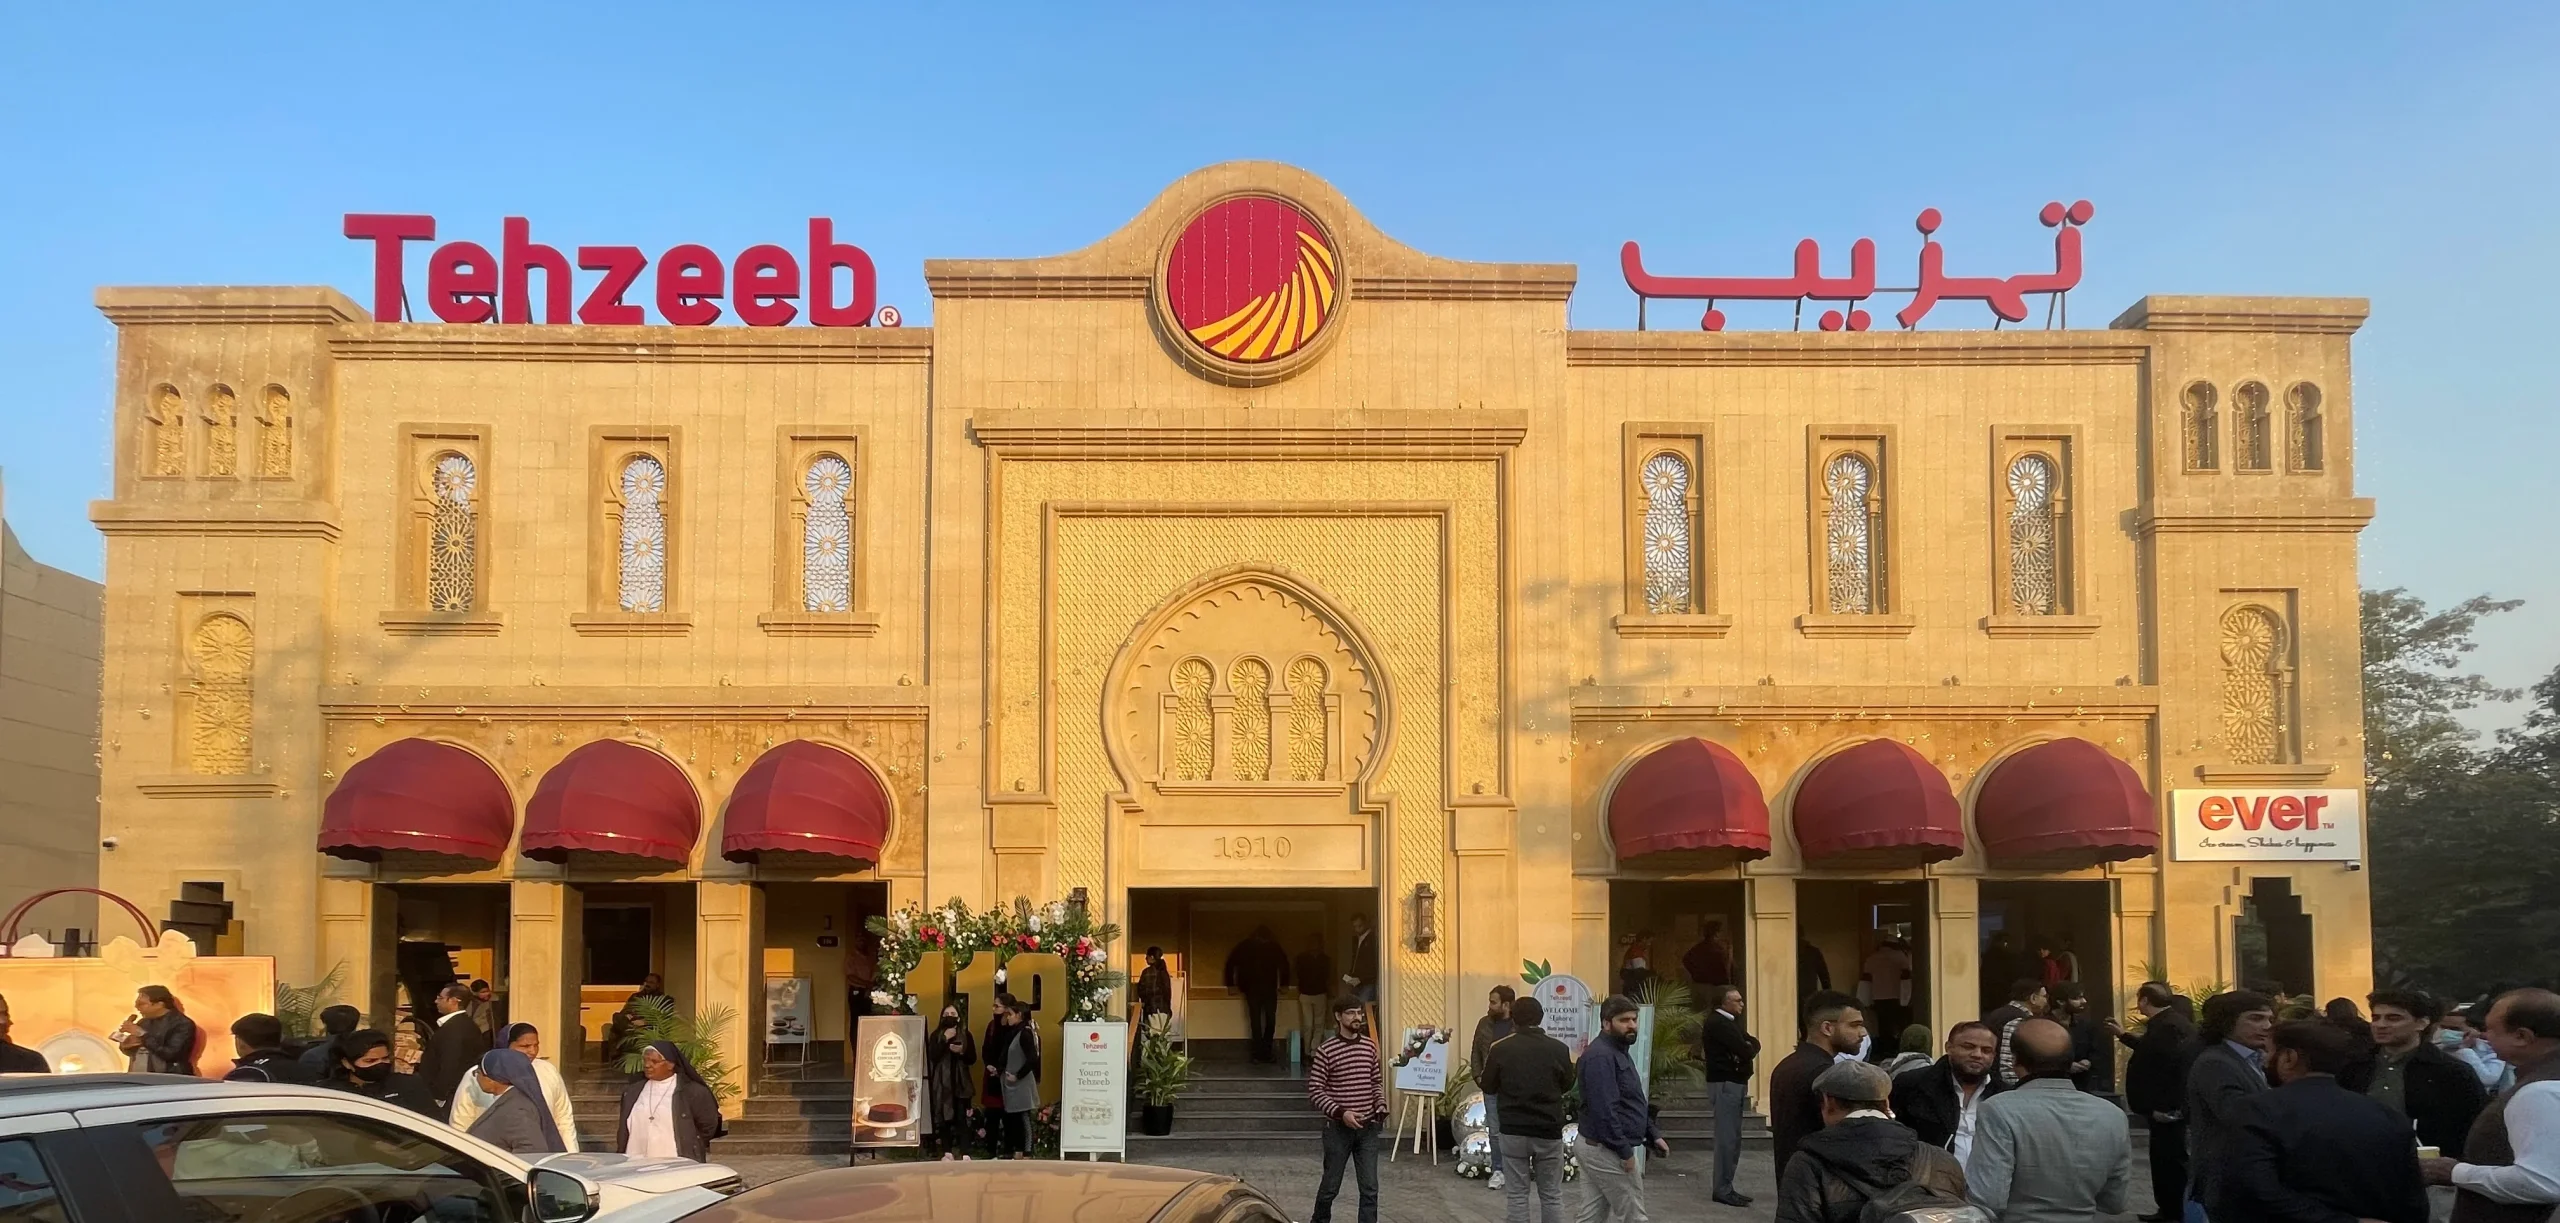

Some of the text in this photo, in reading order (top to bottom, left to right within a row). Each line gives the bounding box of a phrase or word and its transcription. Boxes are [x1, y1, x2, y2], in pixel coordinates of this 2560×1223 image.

[343, 213, 877, 327] Tehzeeb
[2198, 795, 2328, 831] ever
[1213, 836, 1291, 860] 1910
[2247, 836, 2284, 848] Shakes
[2285, 839, 2294, 848] &
[2295, 837, 2337, 853] happiness
[1077, 1078, 1110, 1086] Tehzeeb
[1079, 1068, 1109, 1077] Youm-e
